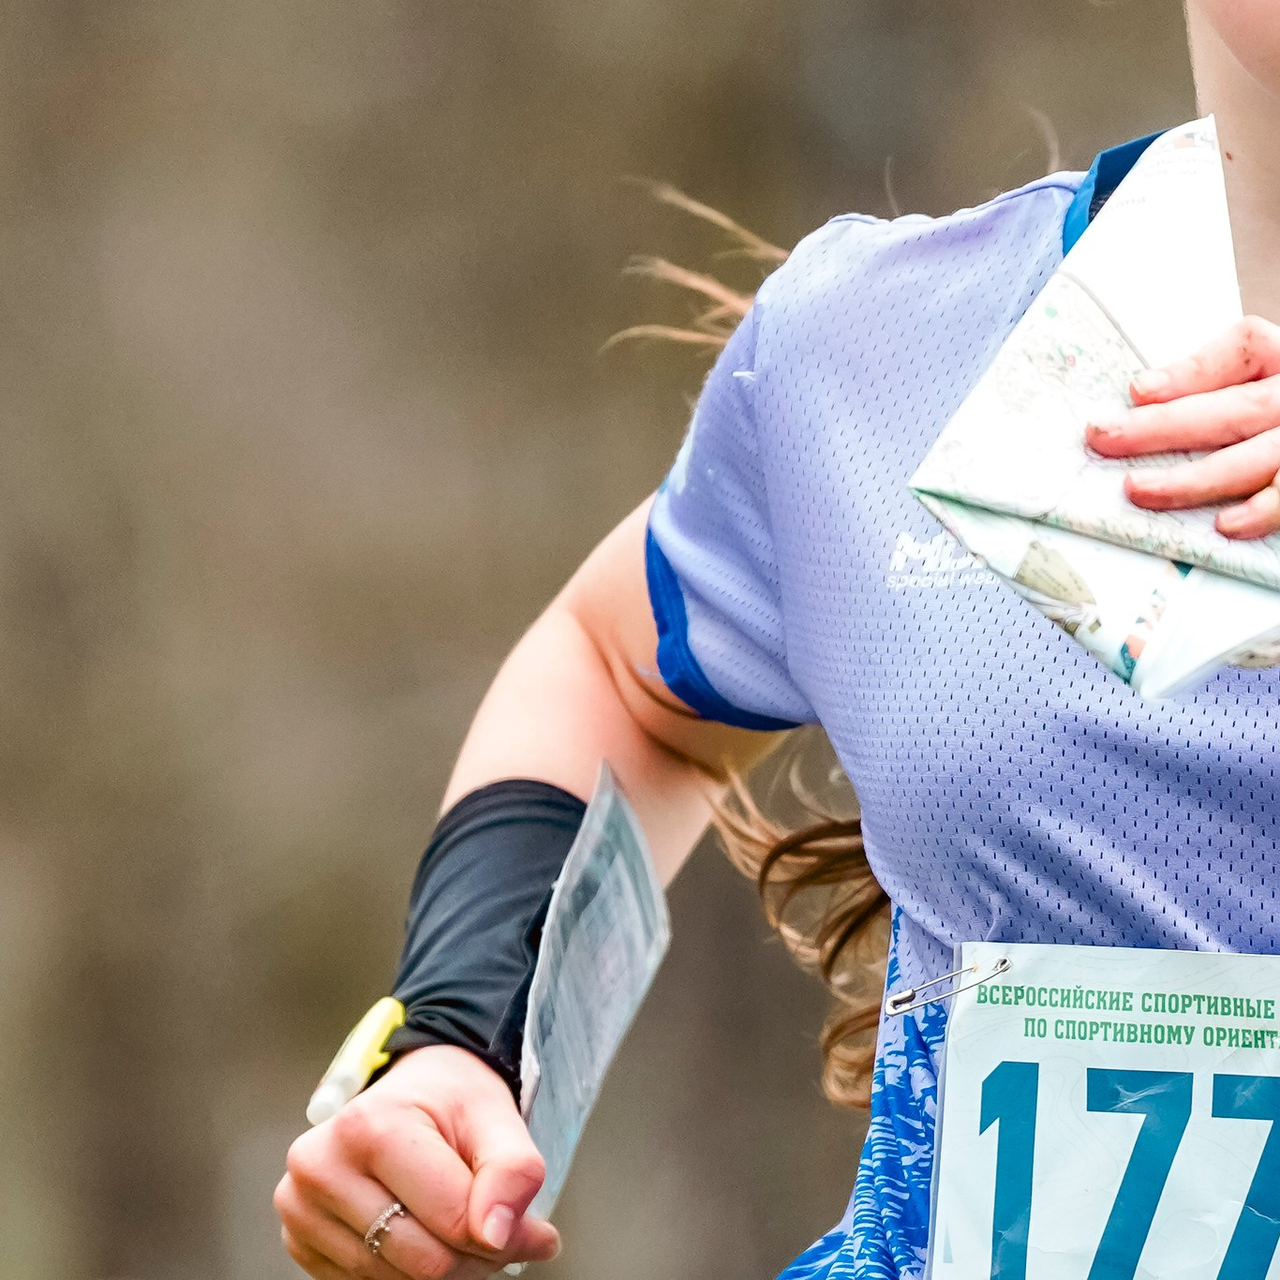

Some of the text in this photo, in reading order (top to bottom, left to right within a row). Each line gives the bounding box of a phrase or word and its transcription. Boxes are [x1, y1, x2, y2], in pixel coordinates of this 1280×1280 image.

[886, 571, 955, 592] special
[976, 984, 1133, 1012] ВСЕРОССИЙСКИЕ
[1141, 992, 1275, 1019] СПОРТИВНЫЕ
[1023, 1017, 1047, 1039] ПО
[1054, 1019, 1195, 1046] СПОРТИВНОМУ
